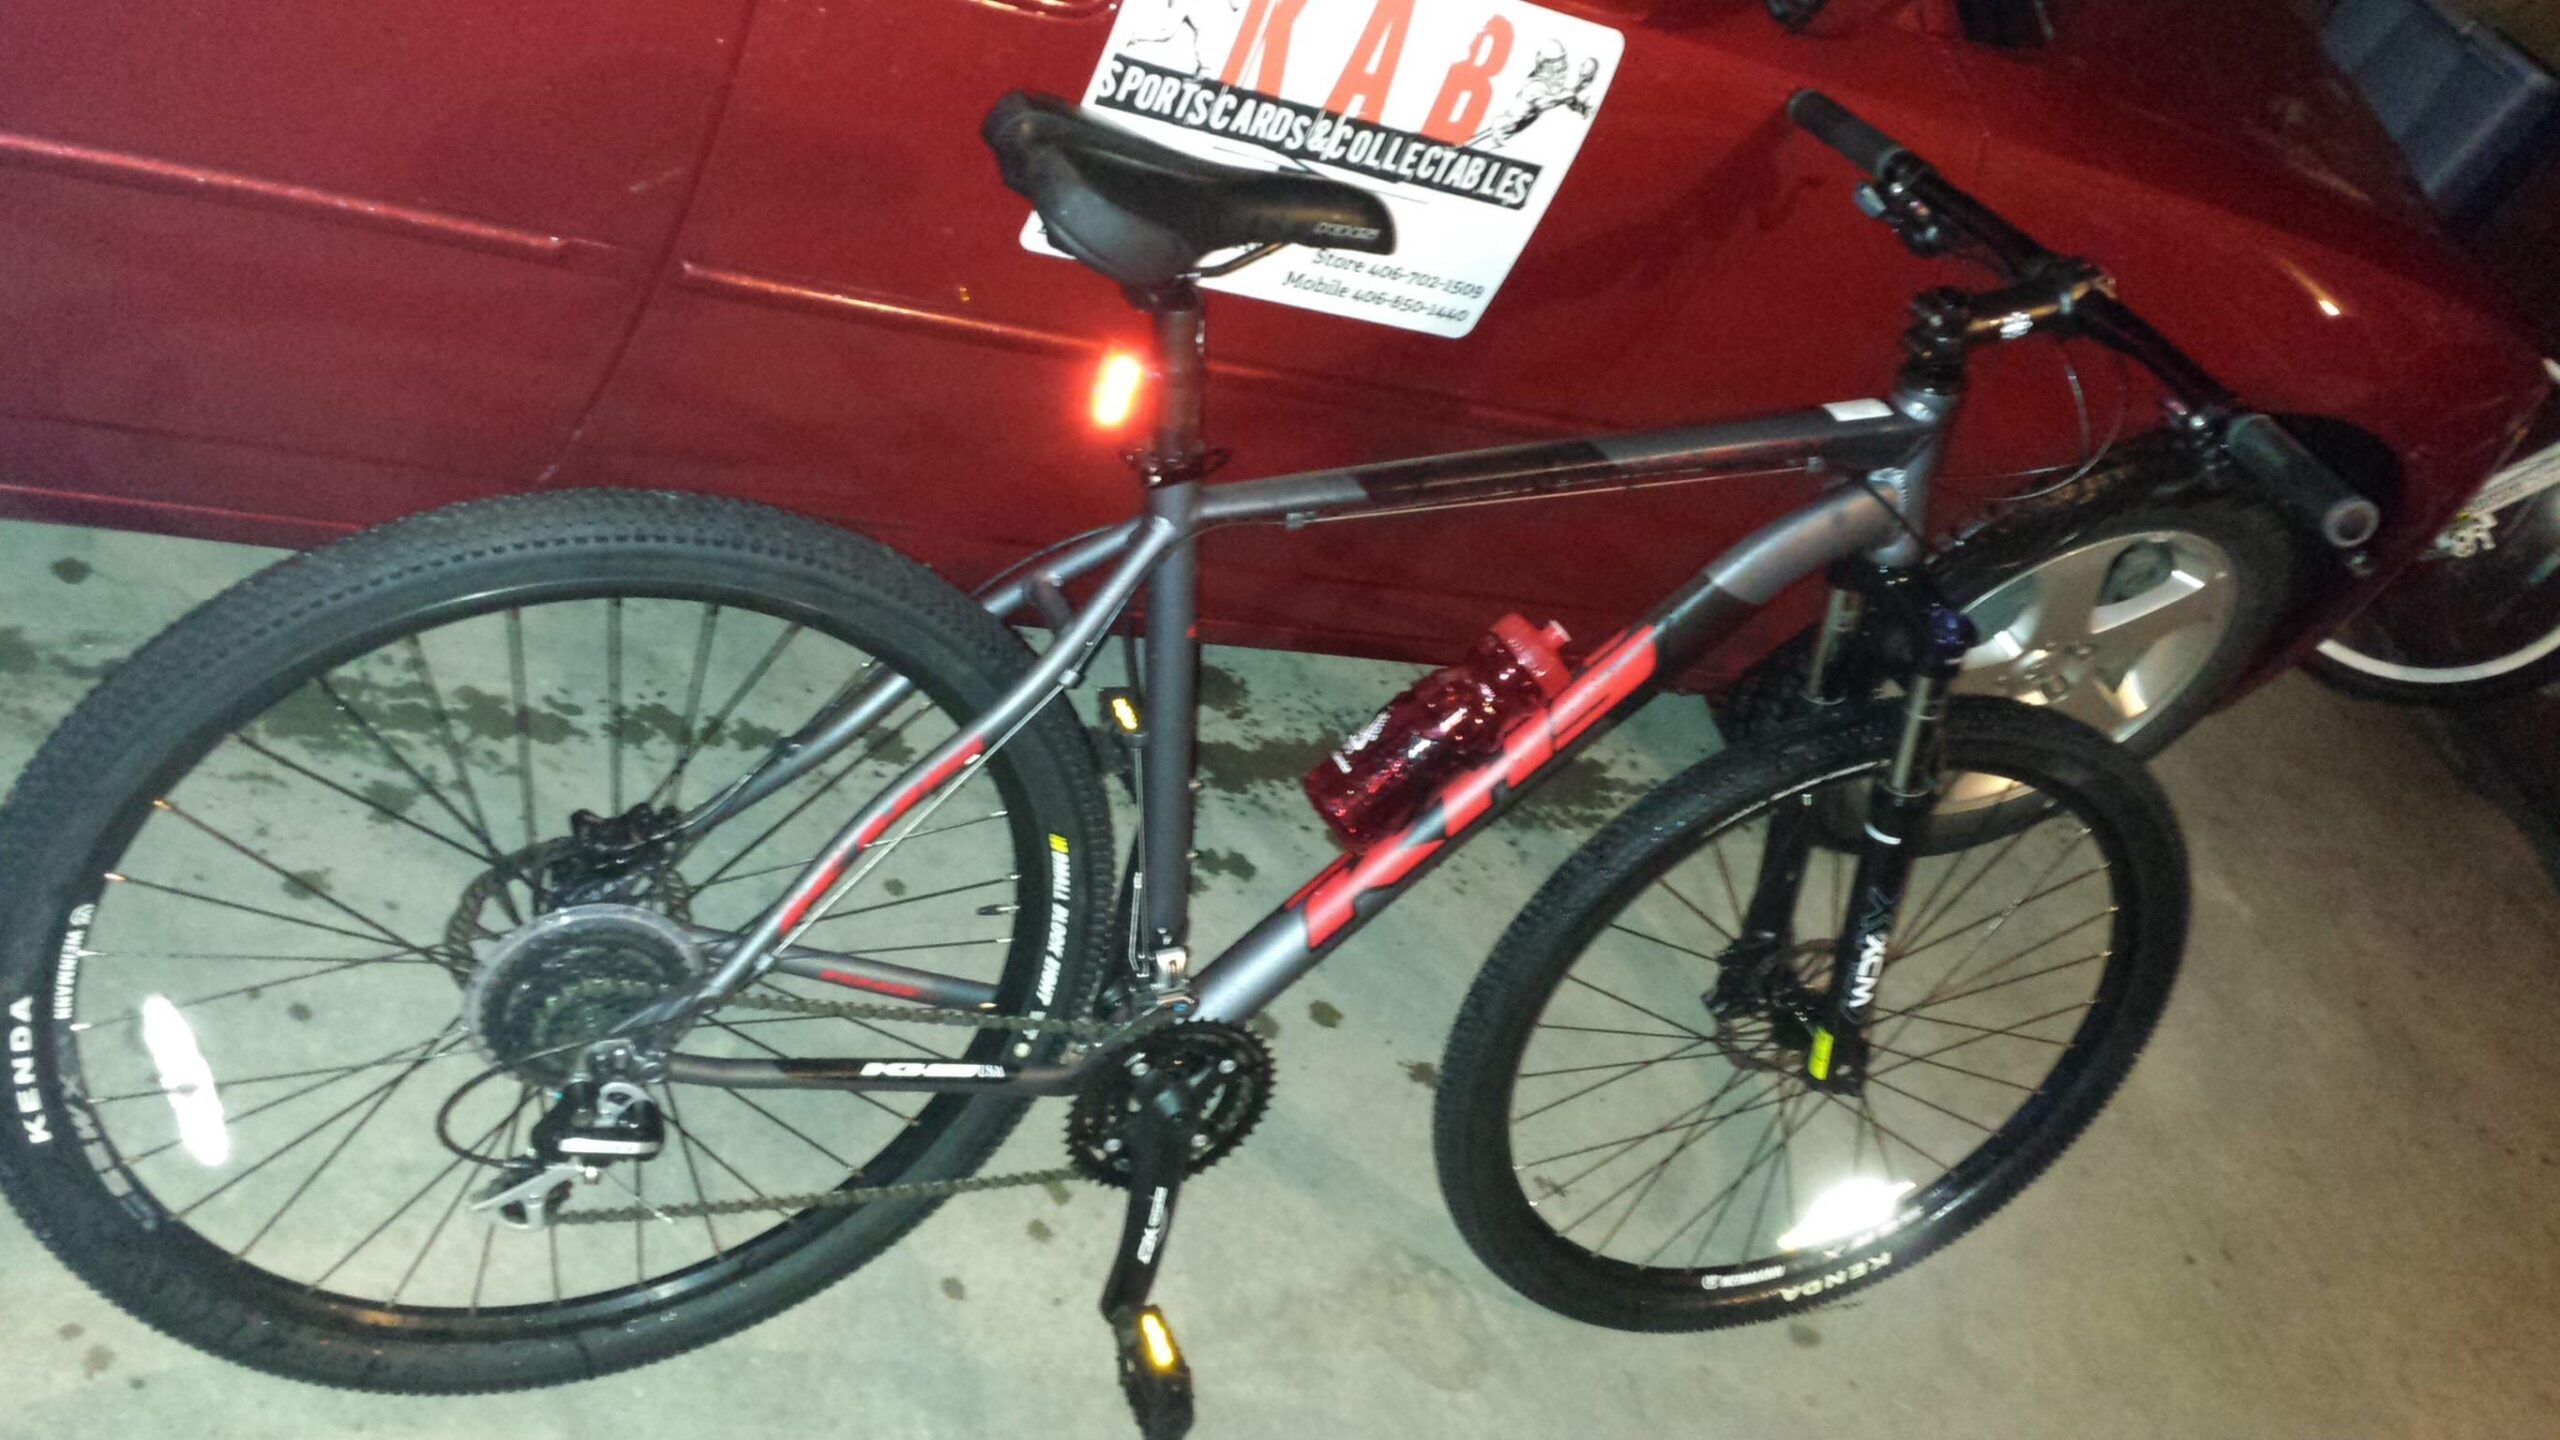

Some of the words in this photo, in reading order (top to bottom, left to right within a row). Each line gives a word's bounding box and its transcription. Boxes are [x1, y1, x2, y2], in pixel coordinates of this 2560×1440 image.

[1282, 271, 1350, 298] Mobile
[1312, 248, 1365, 273] Store
[1368, 264, 1486, 299] 406-702-1509
[8, 995, 54, 1144] KENDA
[1778, 1250, 1893, 1302] KENDA
